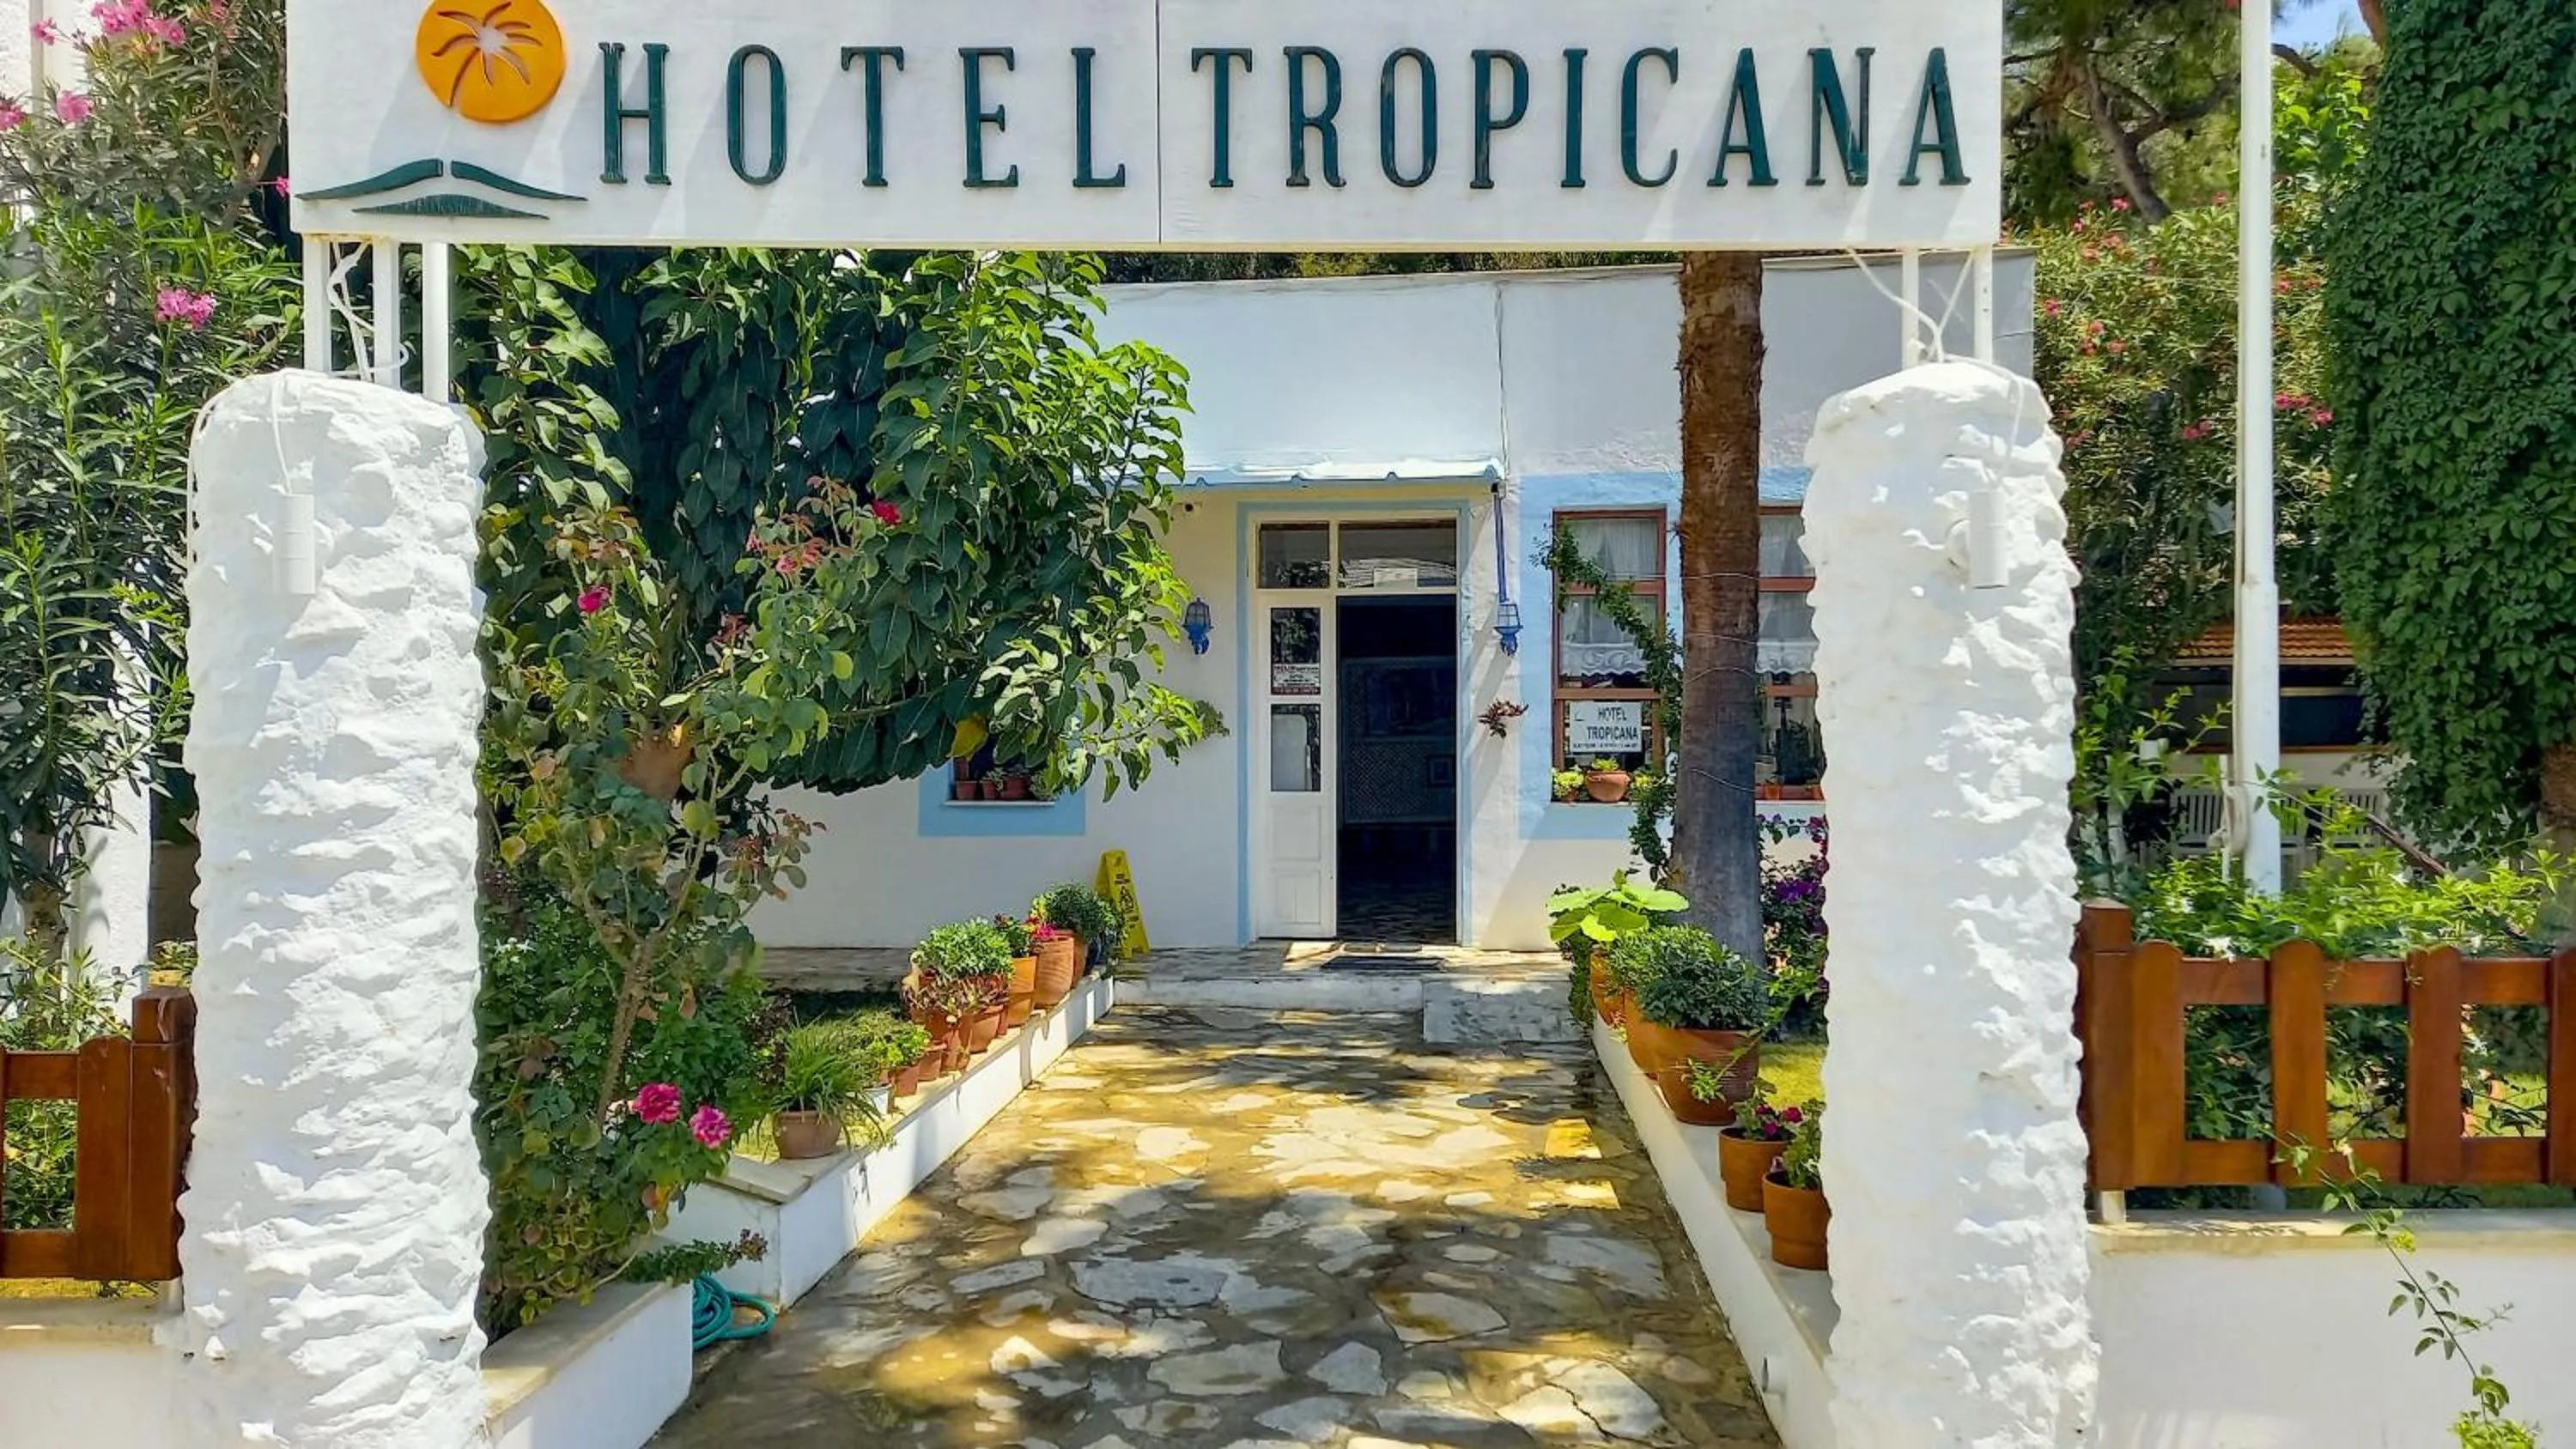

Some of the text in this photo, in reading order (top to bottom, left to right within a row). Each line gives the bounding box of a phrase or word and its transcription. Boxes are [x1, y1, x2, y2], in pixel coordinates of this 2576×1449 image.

[598, 42, 1971, 190] HOTEL TROPICANA
[1598, 706, 1627, 721] HOTEL
[1587, 725, 1638, 739] TROPICANA
